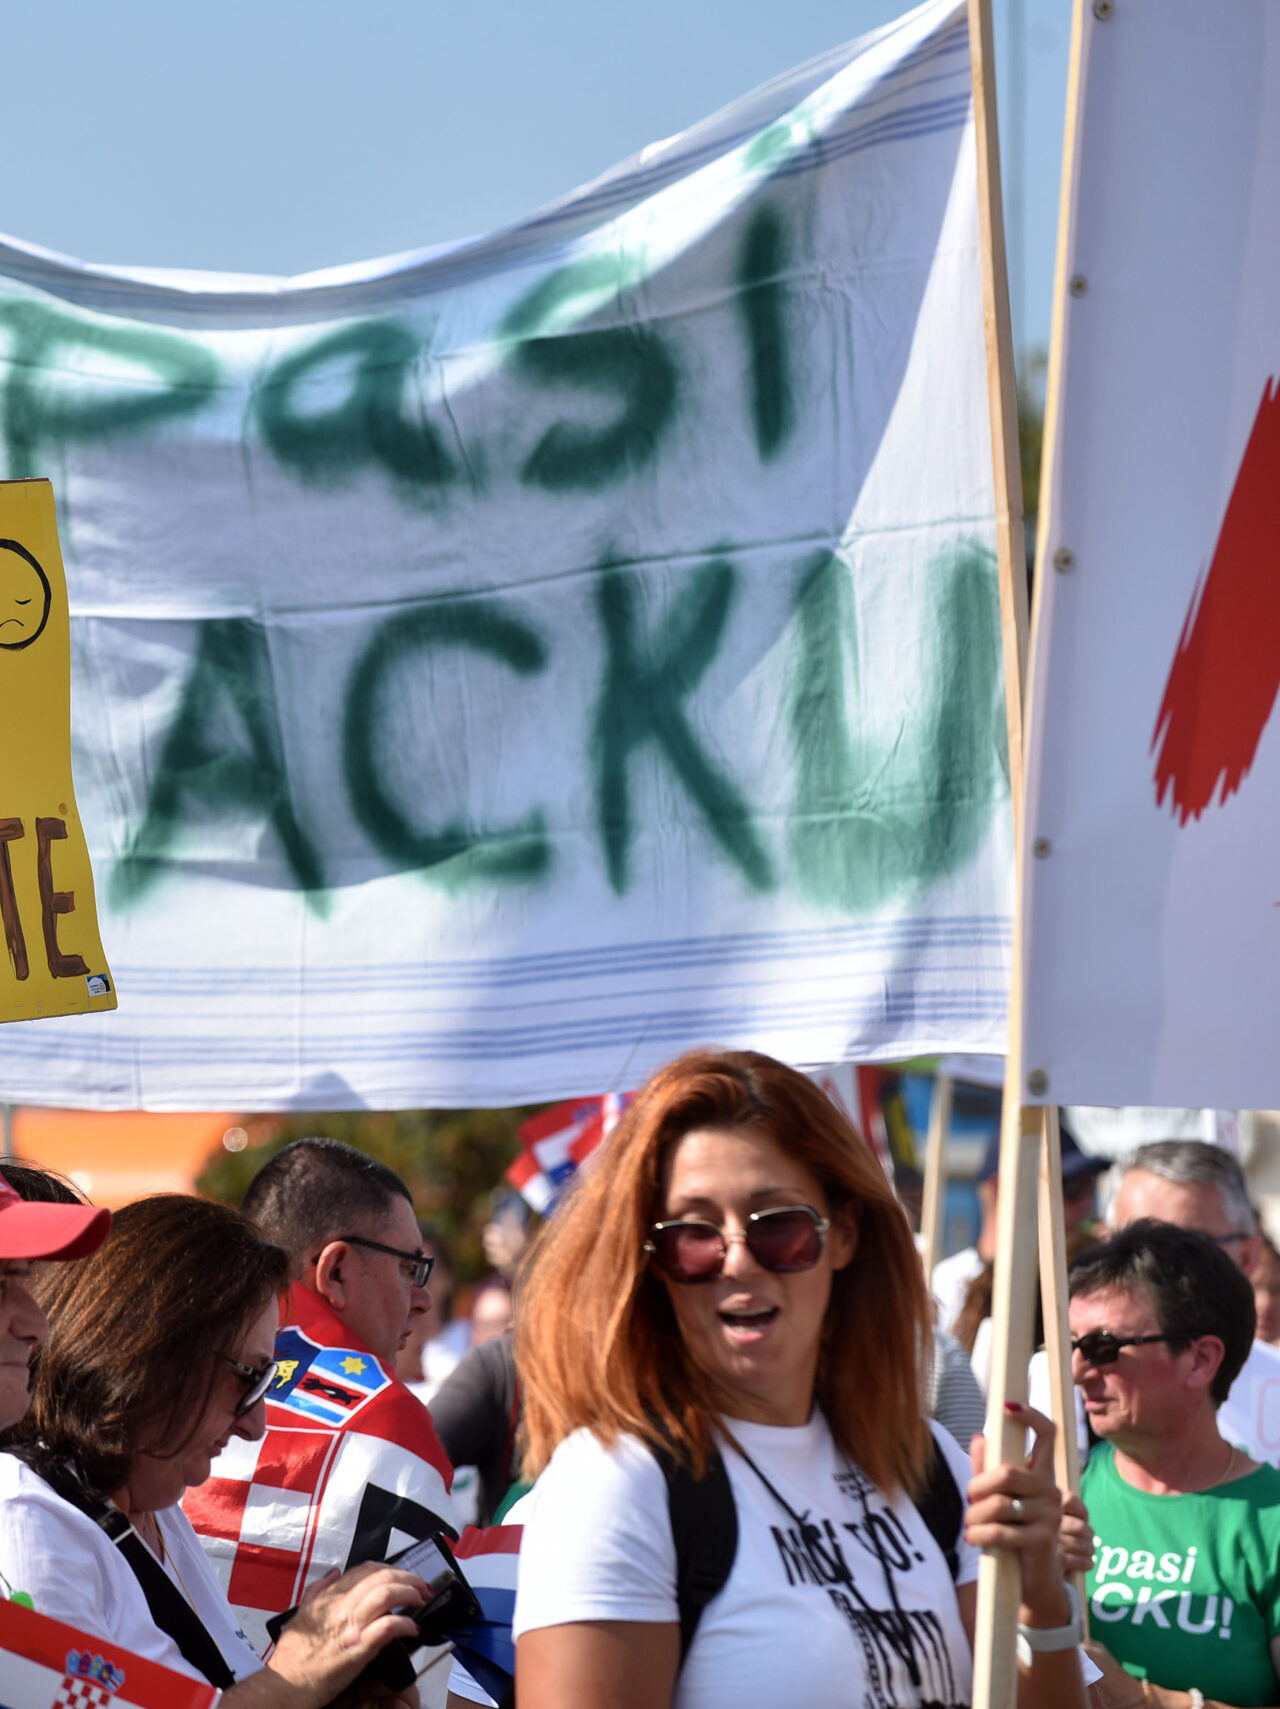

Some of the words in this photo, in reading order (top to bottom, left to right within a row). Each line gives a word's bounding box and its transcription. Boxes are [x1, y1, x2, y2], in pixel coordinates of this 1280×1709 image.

[108, 538, 1002, 918] ACKU
[1093, 1535, 1198, 1584] pasi
[1091, 1582, 1234, 1639] CKU!
